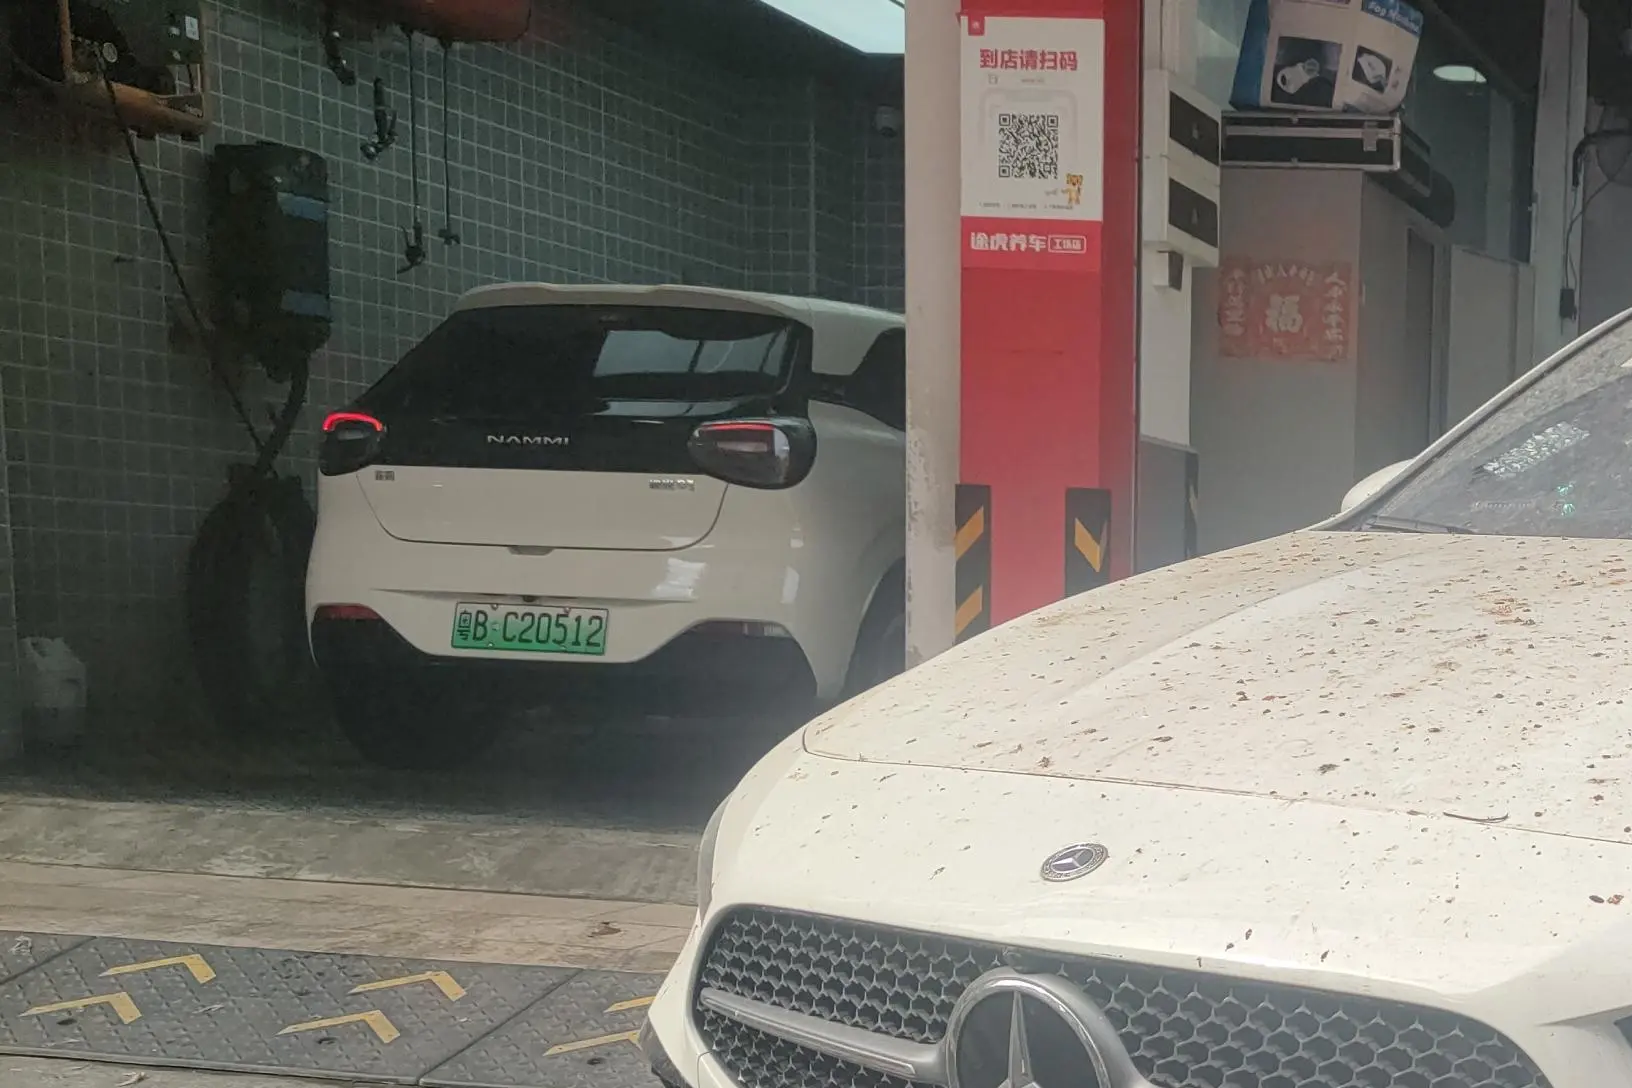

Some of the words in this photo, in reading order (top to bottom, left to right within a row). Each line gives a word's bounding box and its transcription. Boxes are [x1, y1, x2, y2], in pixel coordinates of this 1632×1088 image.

[979, 48, 1078, 71] 到店请扫码
[970, 231, 1047, 252] 途虎养车
[1265, 293, 1303, 333] 福
[487, 435, 569, 445] NAMMI
